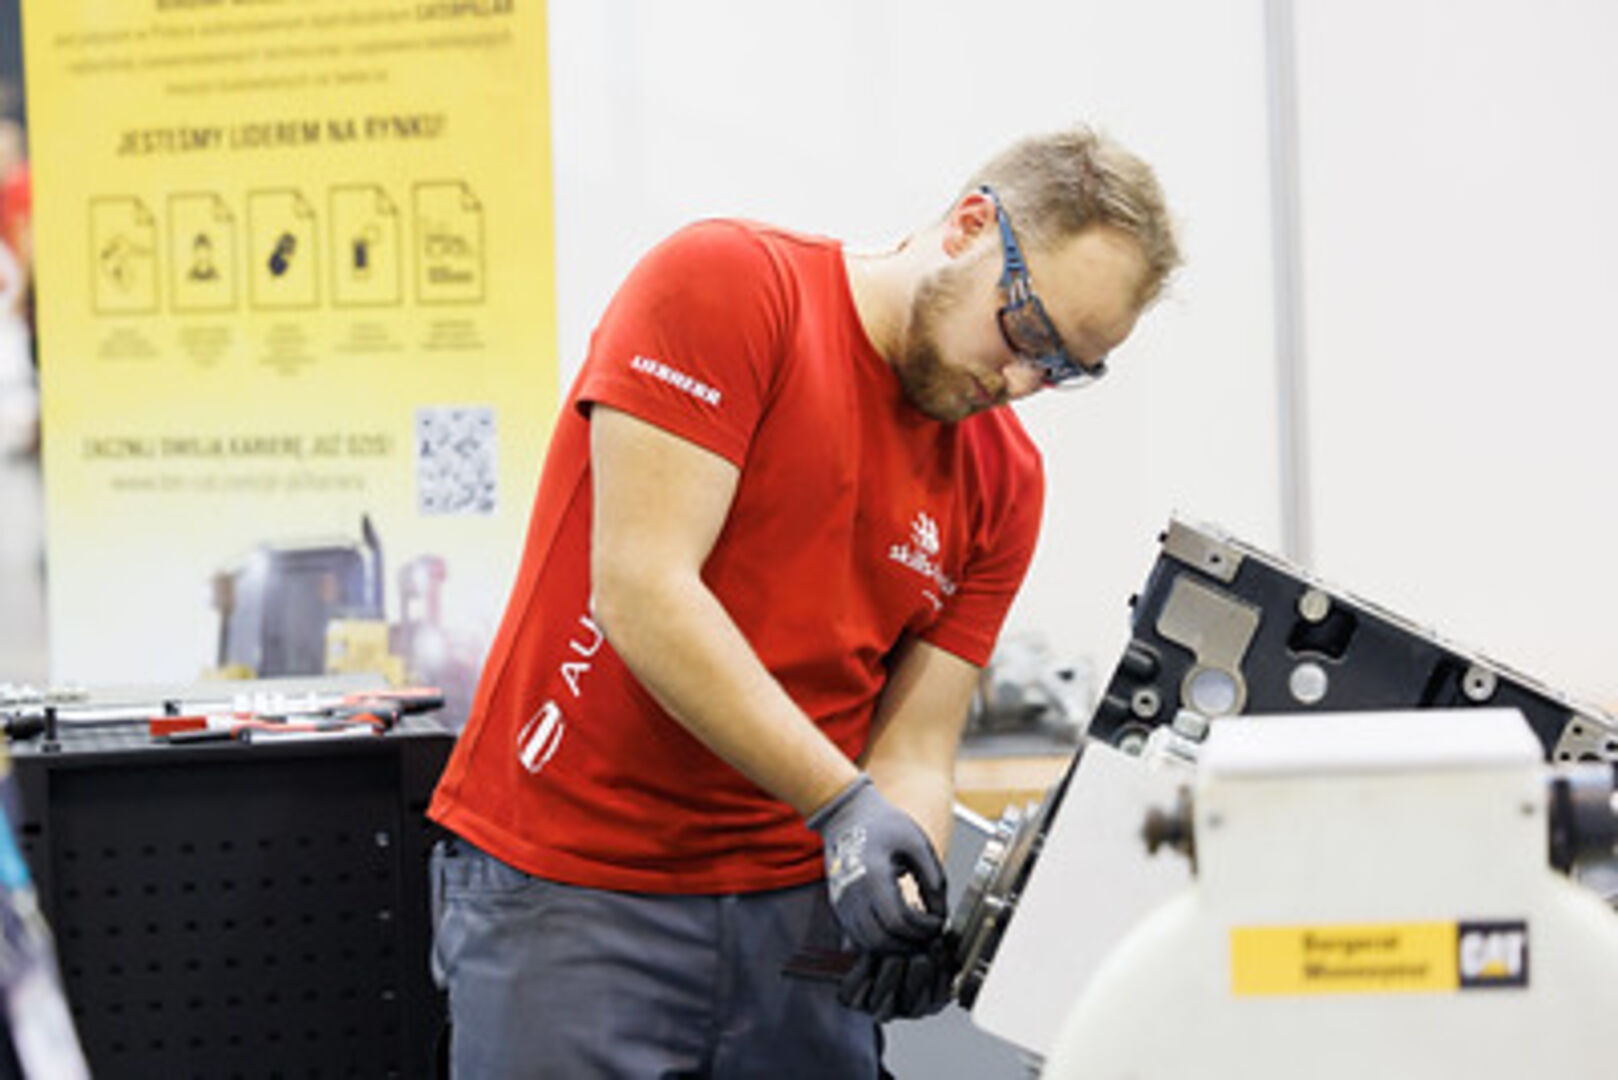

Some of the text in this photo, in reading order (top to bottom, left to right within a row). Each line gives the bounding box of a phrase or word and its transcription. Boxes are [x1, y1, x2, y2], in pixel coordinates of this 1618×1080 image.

[327, 116, 358, 142] NA
[560, 615, 604, 697] AU
[1461, 930, 1525, 979] CAT
